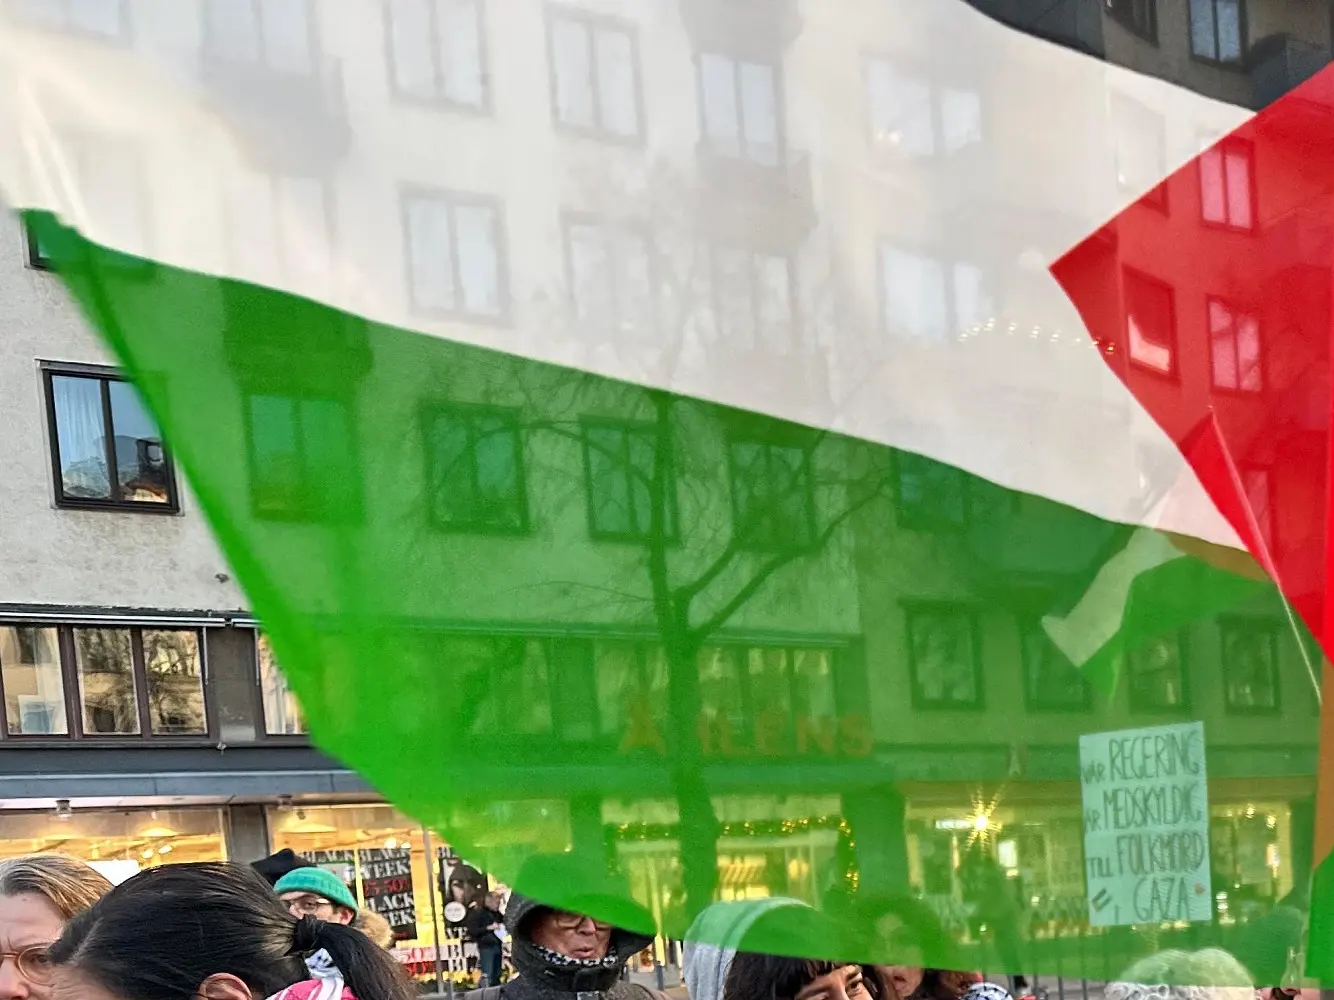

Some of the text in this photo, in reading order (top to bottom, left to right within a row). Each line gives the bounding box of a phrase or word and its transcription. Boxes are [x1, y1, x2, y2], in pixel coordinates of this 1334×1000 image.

[1108, 730, 1201, 781] REGERING
[1102, 784, 1202, 831] MEDSKYLDIG
[1088, 831, 1206, 878] TILL FOLKMORD
[1133, 876, 1190, 922] GAZA
